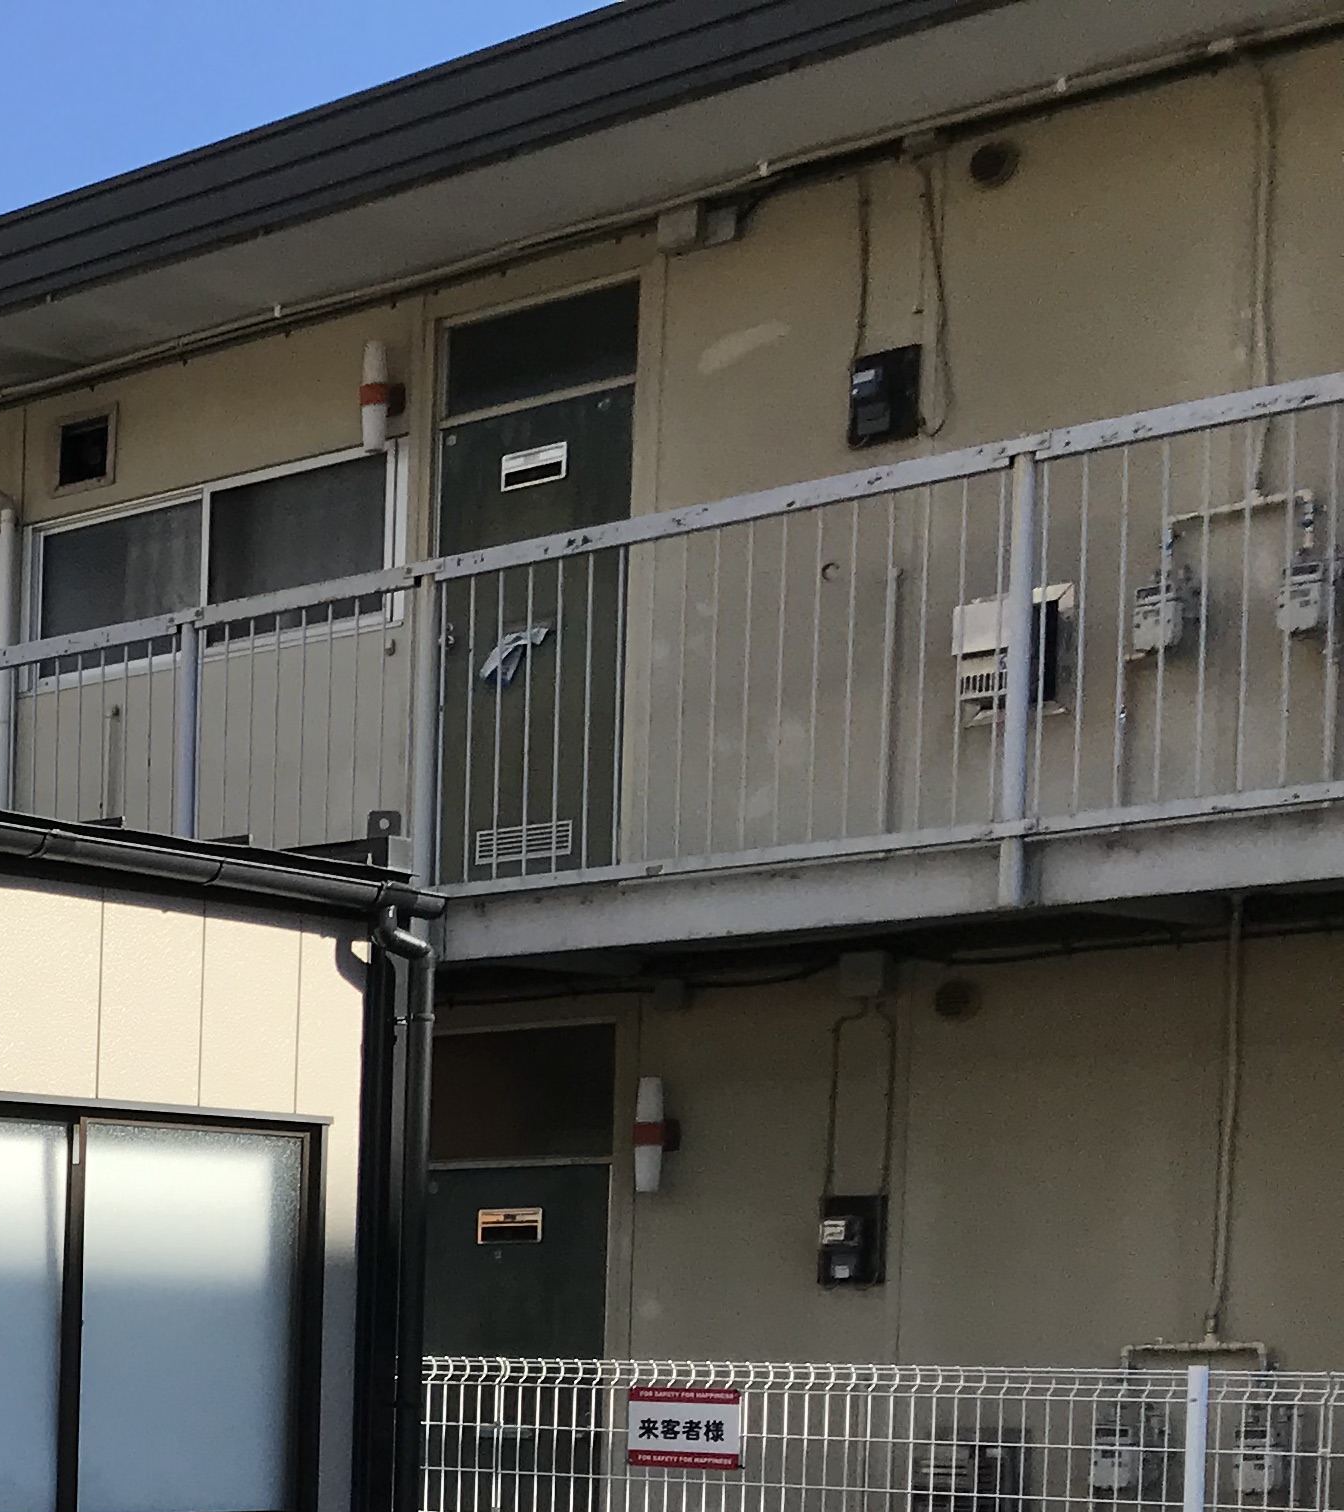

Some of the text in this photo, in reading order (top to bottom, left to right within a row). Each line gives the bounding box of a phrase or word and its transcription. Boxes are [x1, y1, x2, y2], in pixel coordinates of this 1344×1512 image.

[654, 1390, 679, 1398] SAFETY
[638, 1417, 724, 1442] 来客者様
[694, 1457, 732, 1465] HAPPINESS
